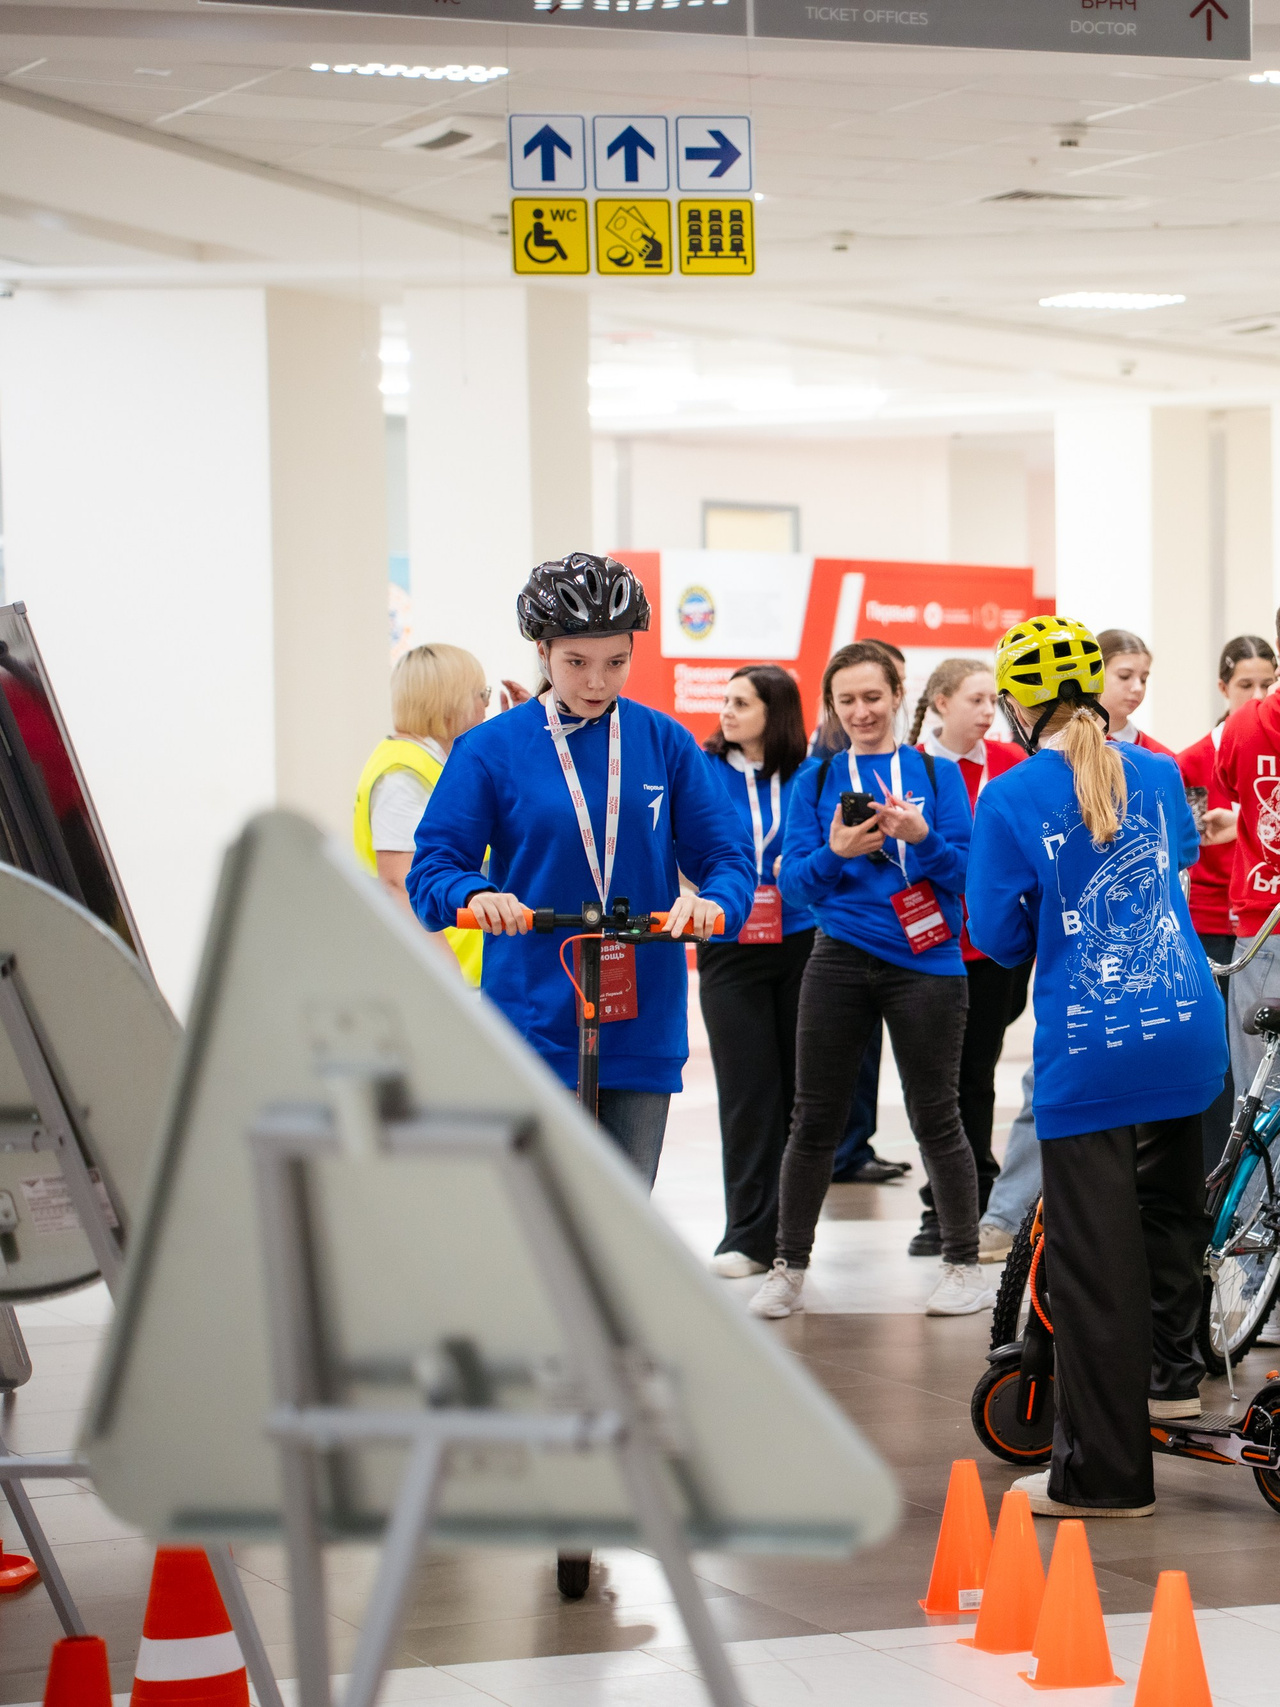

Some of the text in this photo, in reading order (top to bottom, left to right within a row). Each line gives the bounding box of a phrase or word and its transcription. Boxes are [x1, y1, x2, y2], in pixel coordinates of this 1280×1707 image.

[805, 6, 928, 25] TICKET OFFICES
[1070, 20, 1137, 36] DOCTOR
[550, 209, 577, 222] WC
[643, 784, 664, 792] Первые
